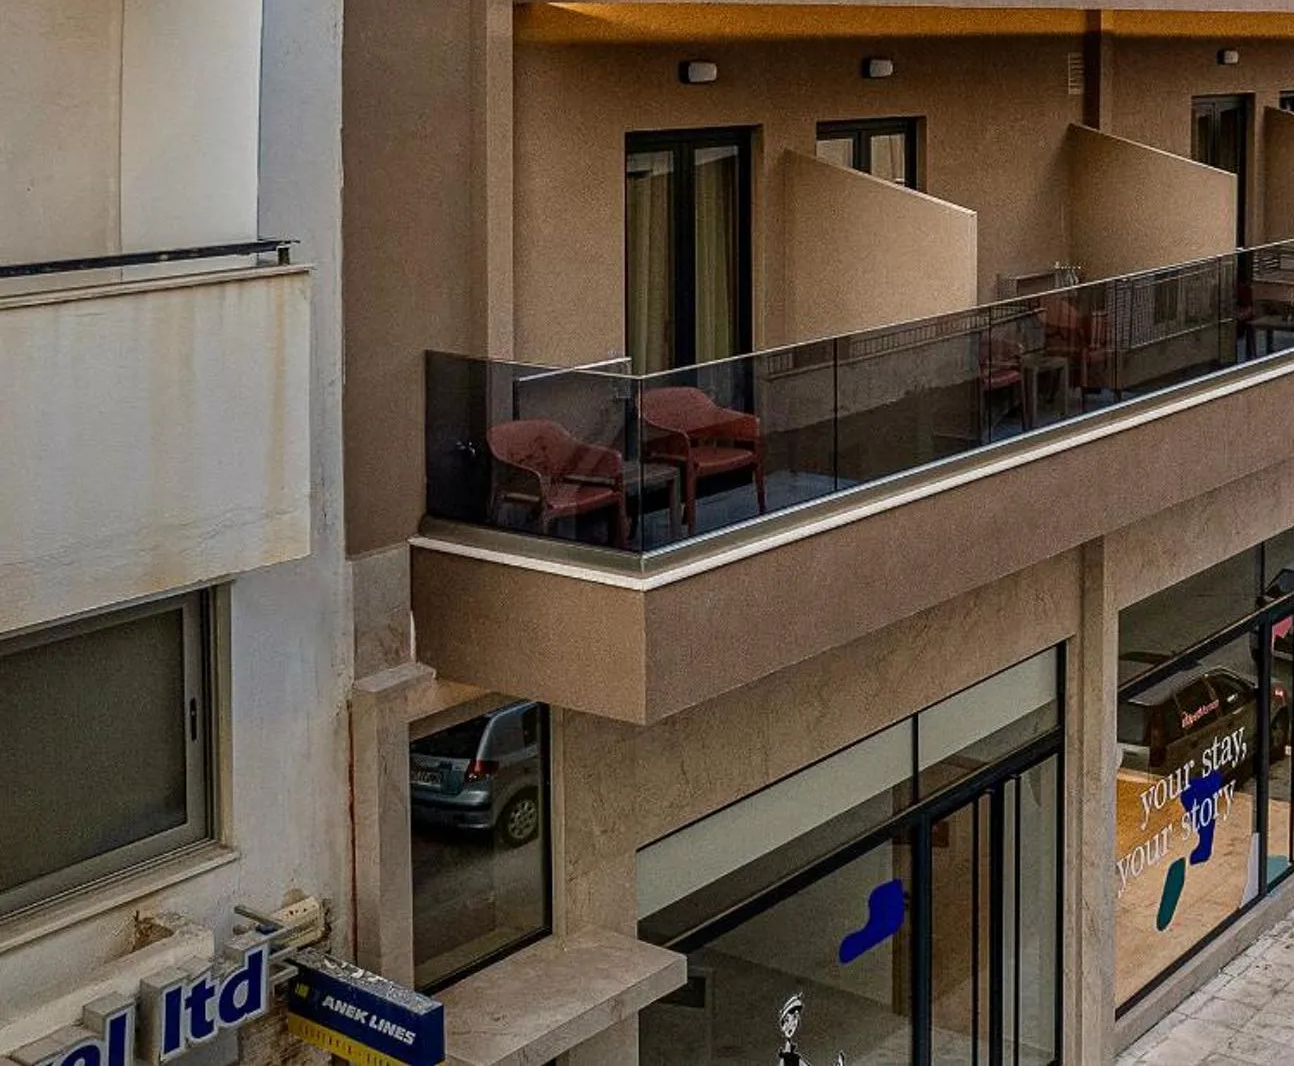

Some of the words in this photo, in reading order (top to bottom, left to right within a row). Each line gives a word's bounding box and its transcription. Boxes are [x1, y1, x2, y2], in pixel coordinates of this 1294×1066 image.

[1140, 759, 1195, 830] your
[1202, 726, 1247, 777] stay,
[1115, 823, 1173, 898] your
[1181, 779, 1236, 839] story
[162, 949, 263, 1055] ltd
[322, 995, 369, 1024] ANEK
[369, 1014, 416, 1045] LINES
